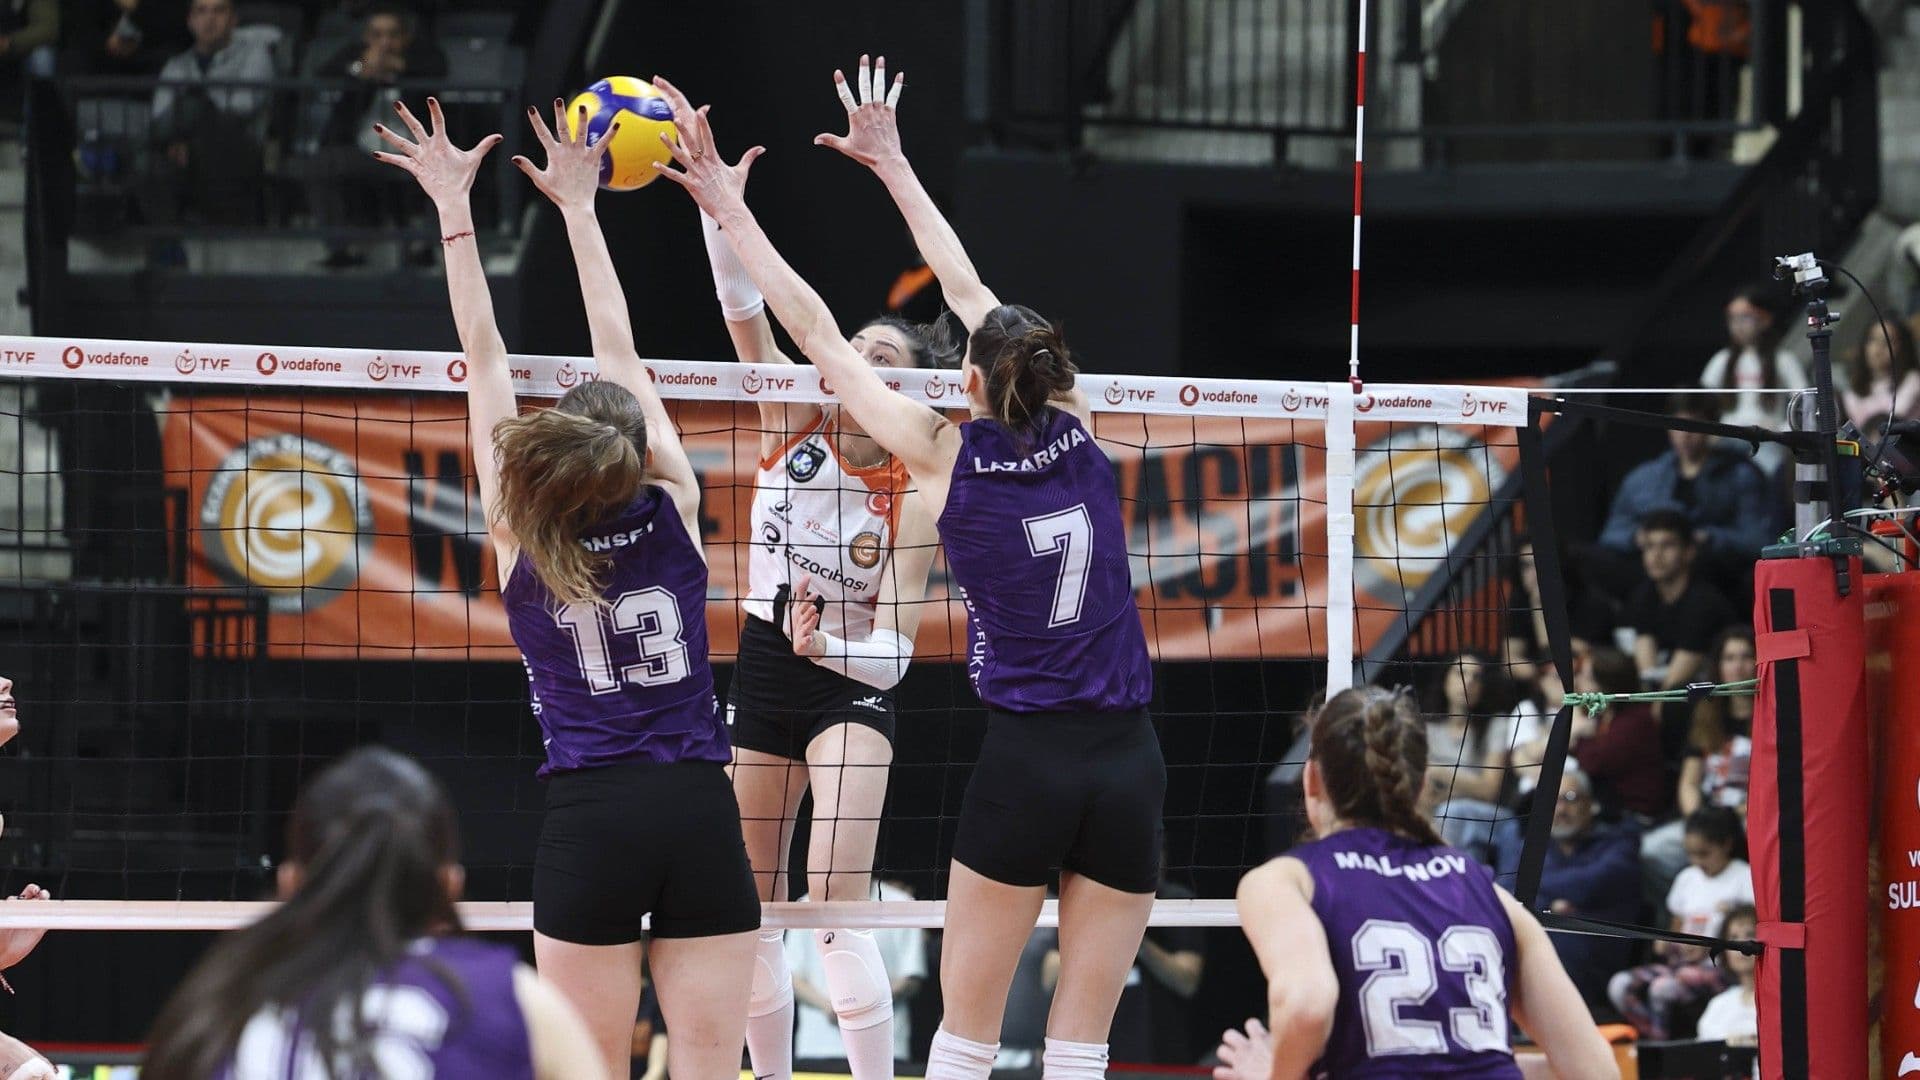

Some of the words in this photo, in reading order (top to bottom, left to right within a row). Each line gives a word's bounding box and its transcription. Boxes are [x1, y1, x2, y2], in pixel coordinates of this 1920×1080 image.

[7, 351, 35, 363] TVF
[87, 352, 149, 366] vodafone
[200, 357, 230, 371] TVF
[281, 358, 341, 373] vodafone
[391, 364, 421, 378] TVF
[581, 371, 600, 383] TV
[659, 373, 718, 386] vodafone
[766, 378, 795, 391] TVF
[948, 383, 967, 395] TV
[1127, 389, 1155, 401] TVF
[1202, 391, 1258, 404] vodafone
[1378, 396, 1432, 409] vodafone
[1480, 401, 1508, 413] TVF
[974, 427, 1086, 474] LAZAREVA
[1021, 502, 1093, 629] 7
[556, 585, 692, 696] 13
[1333, 852, 1466, 881] MALNOV
[1351, 919, 1512, 1058] 23
